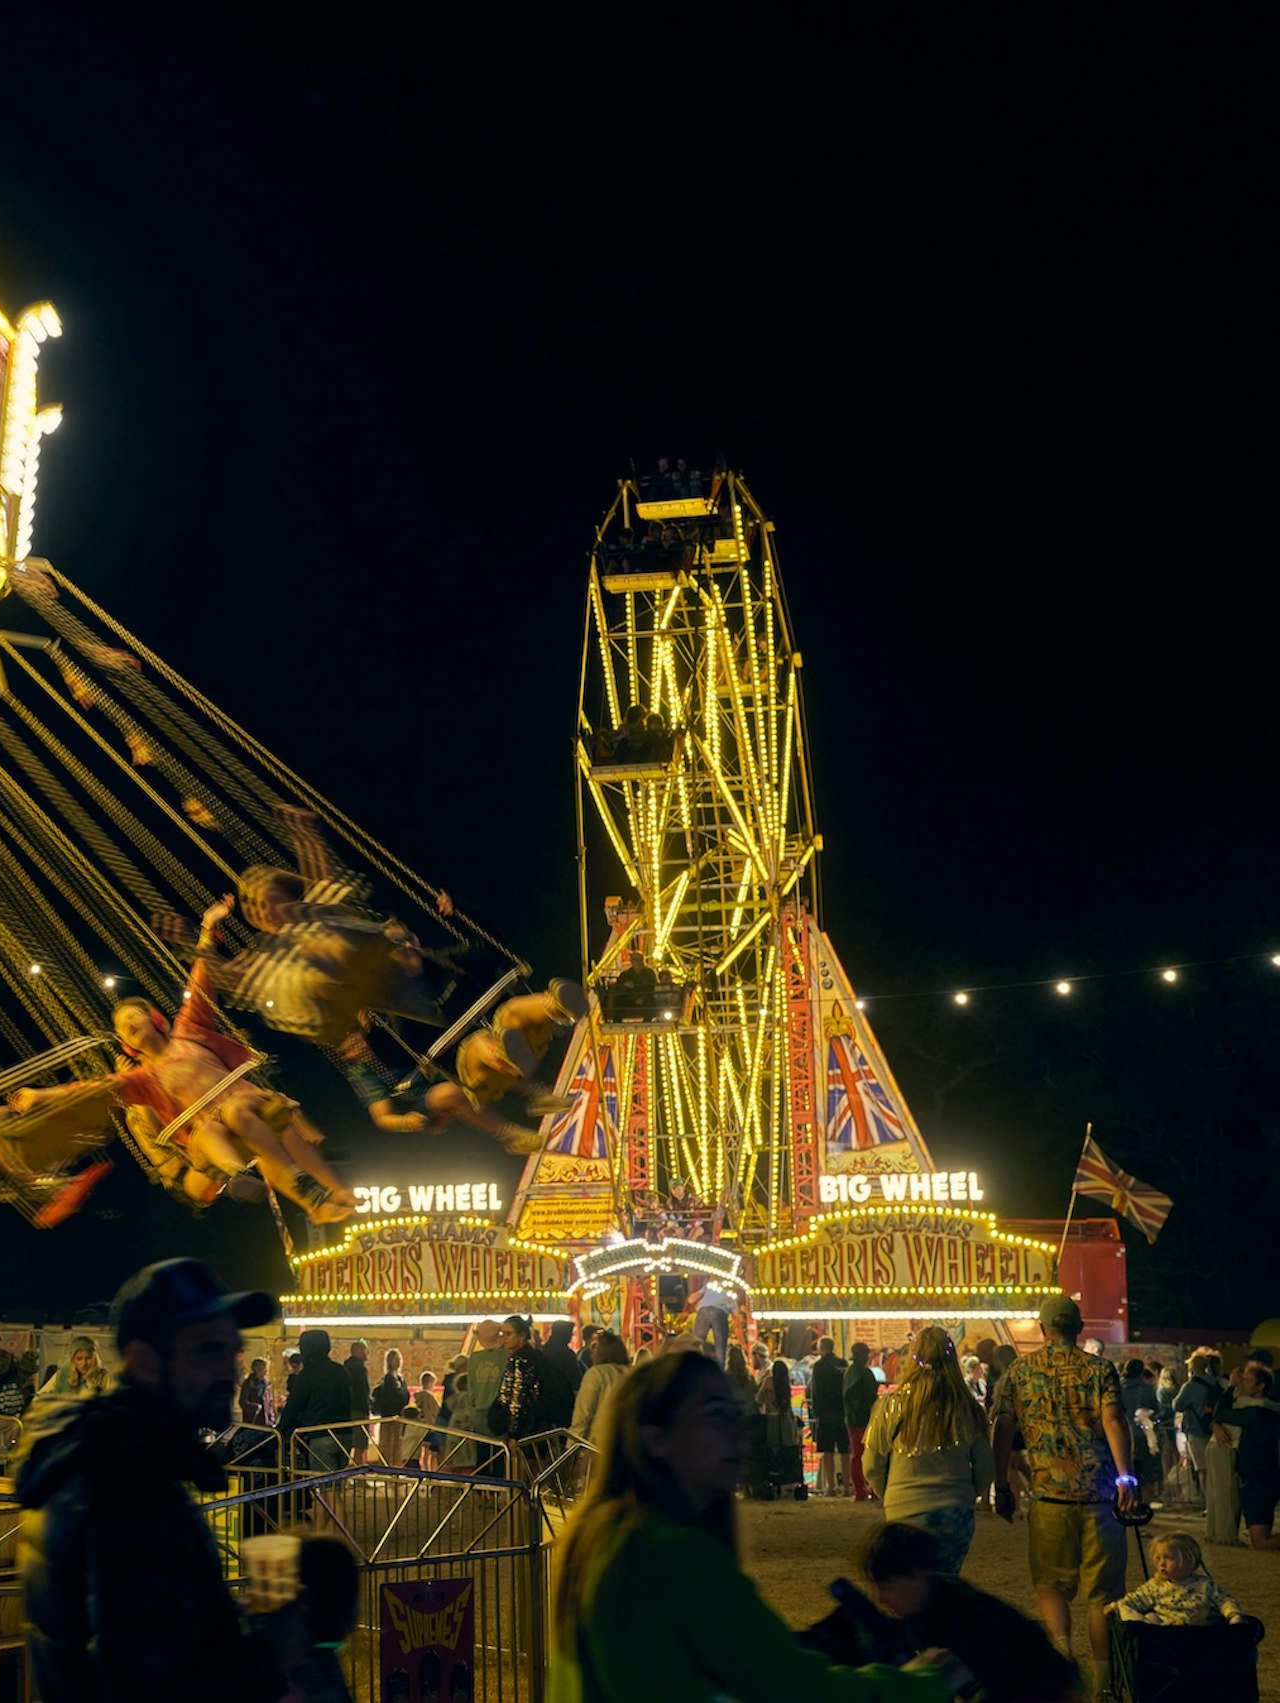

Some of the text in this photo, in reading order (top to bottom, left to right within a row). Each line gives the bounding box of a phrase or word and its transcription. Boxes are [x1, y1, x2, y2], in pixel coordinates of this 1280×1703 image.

[408, 1183, 503, 1212] WHEEL
[818, 1171, 984, 1203] BIG WHEEL
[308, 1243, 423, 1294] FERRIS
[429, 1241, 558, 1293] WHEEL
[770, 1233, 896, 1288] FERRIS
[902, 1233, 1043, 1287] WHEEL
